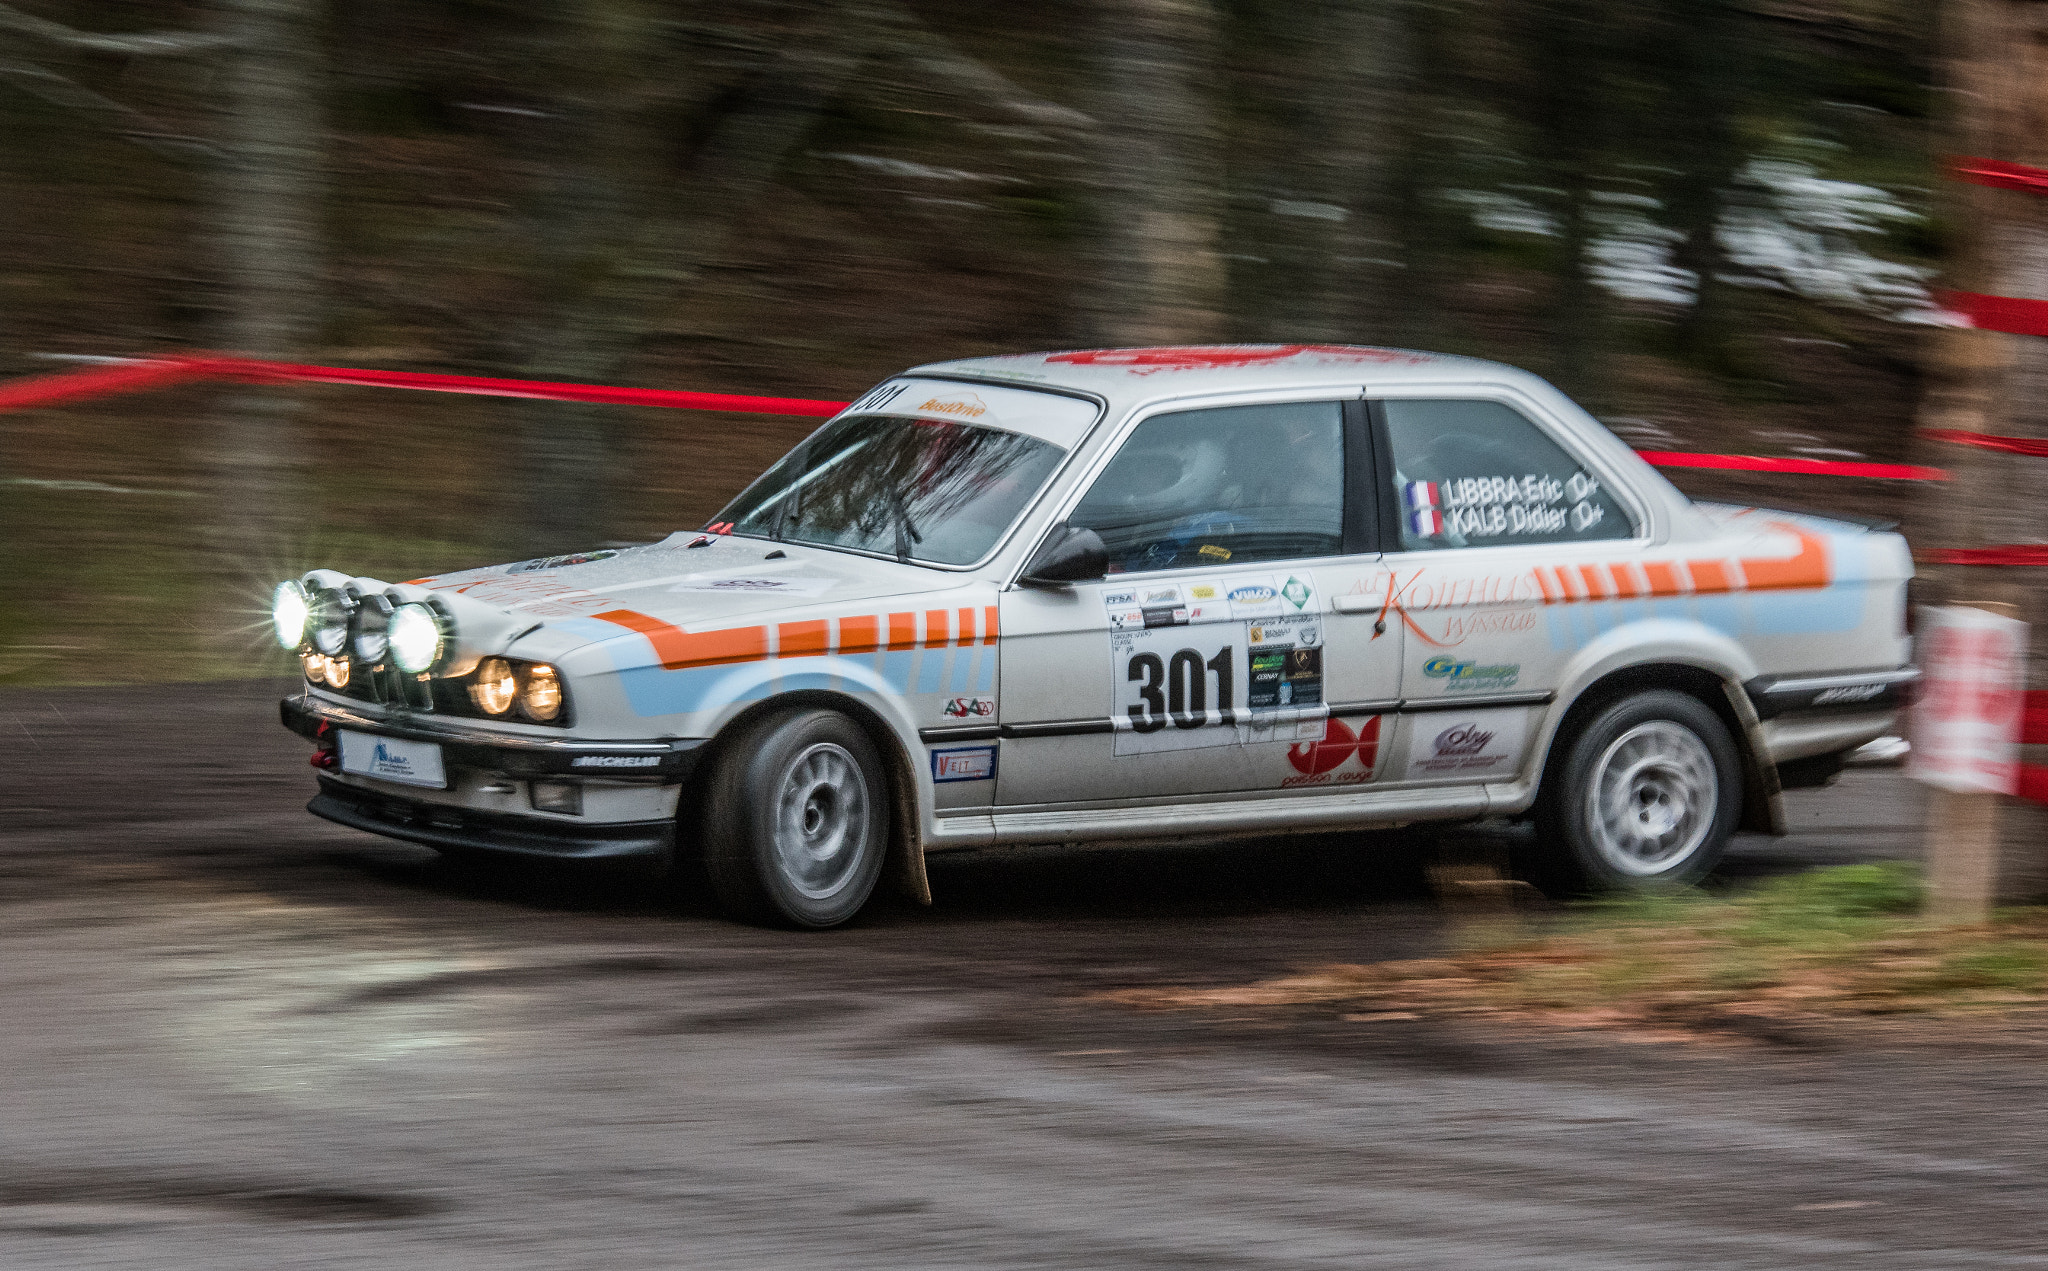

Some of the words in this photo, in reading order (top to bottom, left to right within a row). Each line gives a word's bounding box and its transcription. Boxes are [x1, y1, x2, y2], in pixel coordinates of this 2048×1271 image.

[853, 385, 911, 411] 301
[918, 399, 986, 417] BestDrive
[1442, 475, 1523, 511] LIBBRA
[1521, 473, 1564, 506] Eric
[1448, 504, 1507, 537] KALB
[1506, 501, 1567, 535] Didier
[1233, 590, 1273, 601] VULCO
[1128, 645, 1233, 734] 301
